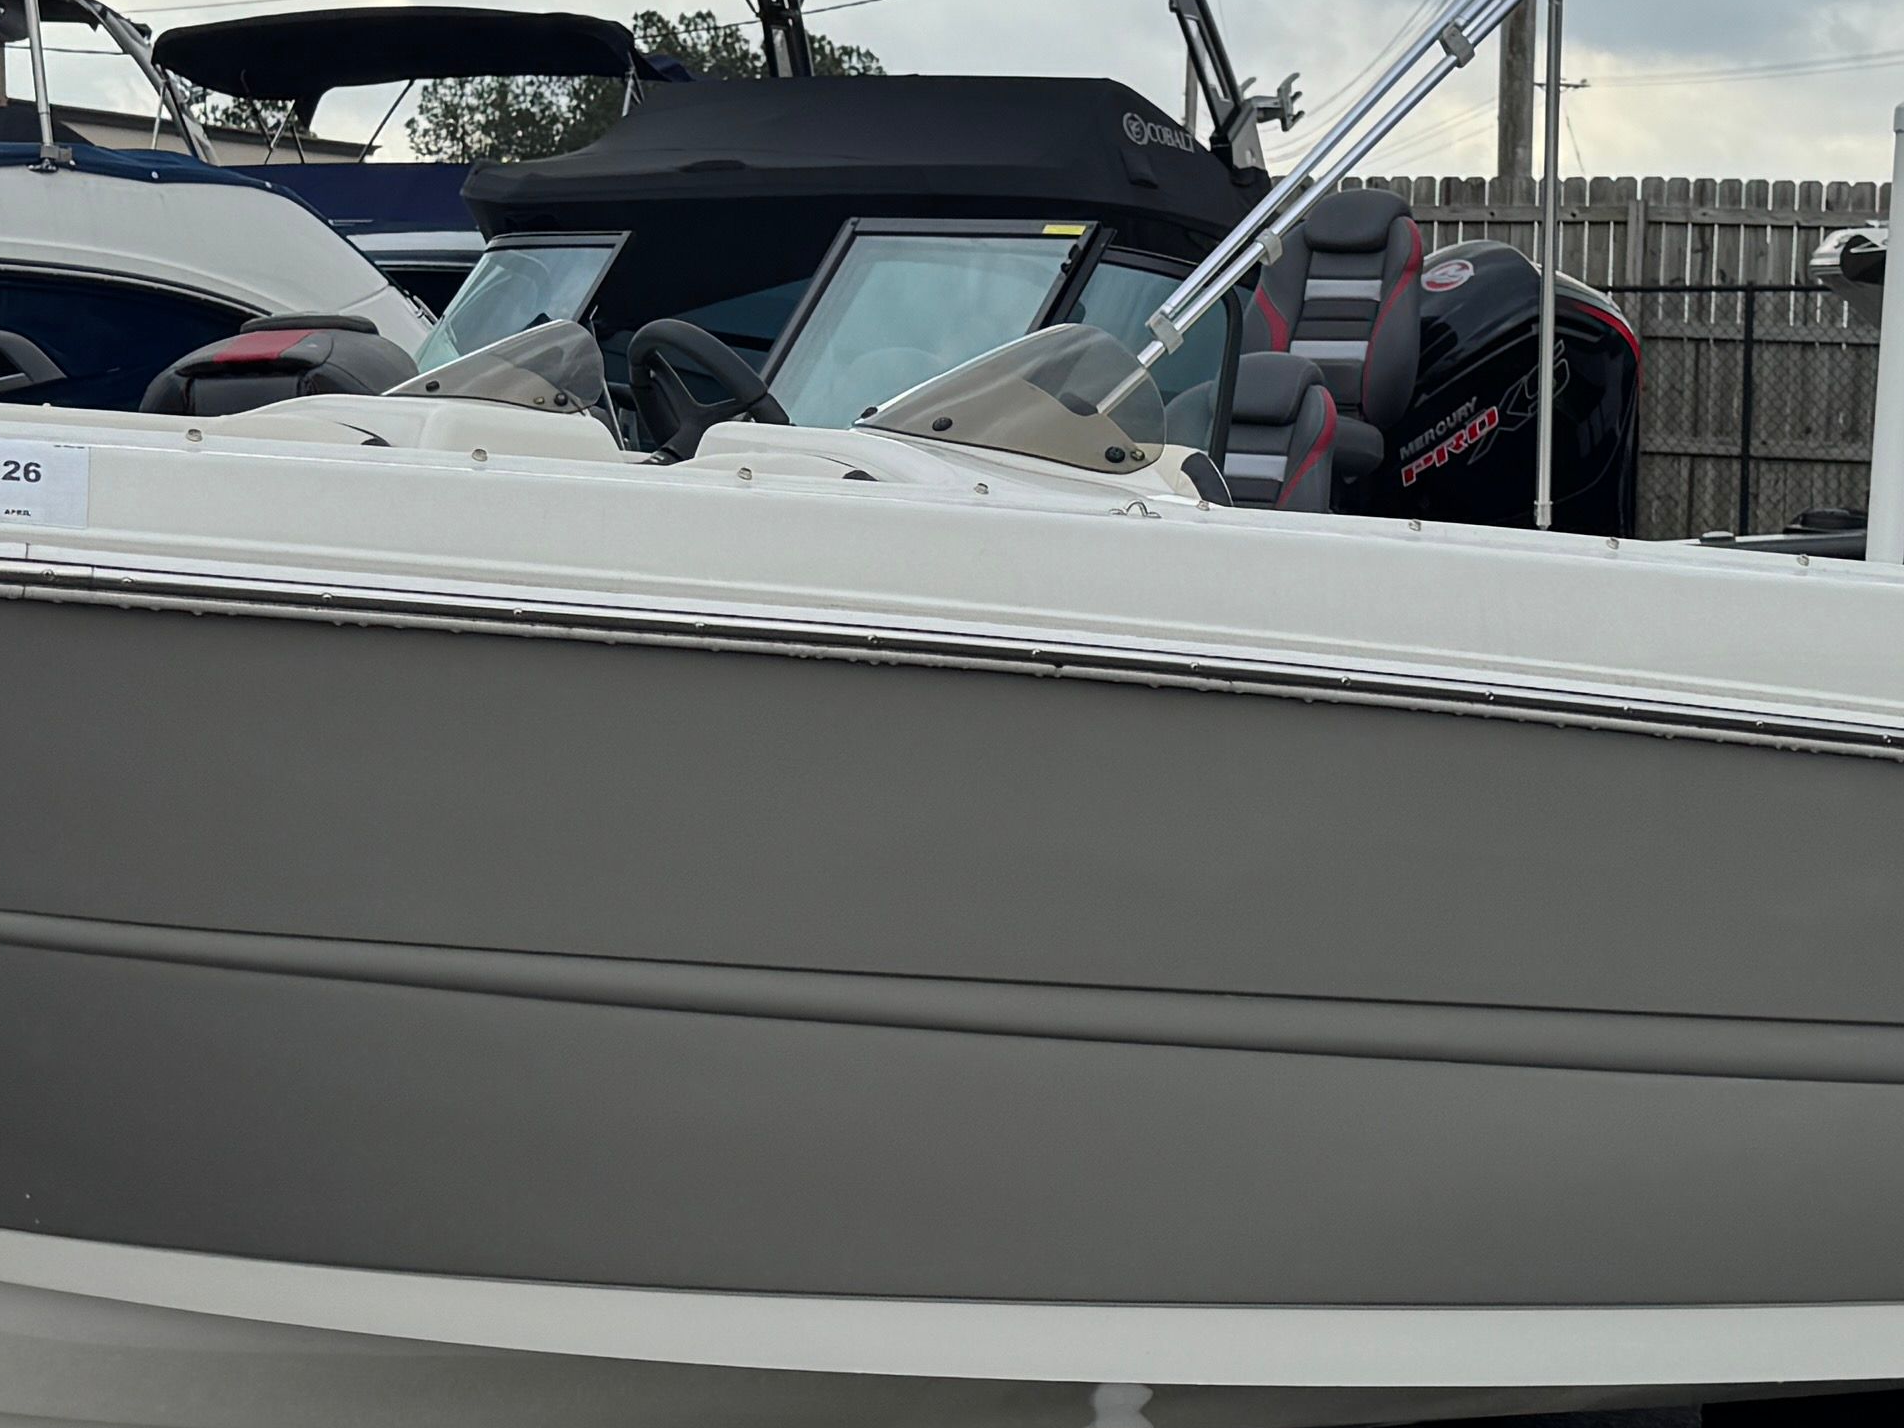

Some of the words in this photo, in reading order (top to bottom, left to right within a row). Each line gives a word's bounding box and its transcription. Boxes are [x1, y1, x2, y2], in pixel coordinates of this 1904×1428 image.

[1147, 122, 1194, 153] COBALT
[1399, 396, 1478, 460] MERCURY
[1401, 406, 1499, 487] PRO
[1, 460, 41, 483] 26
